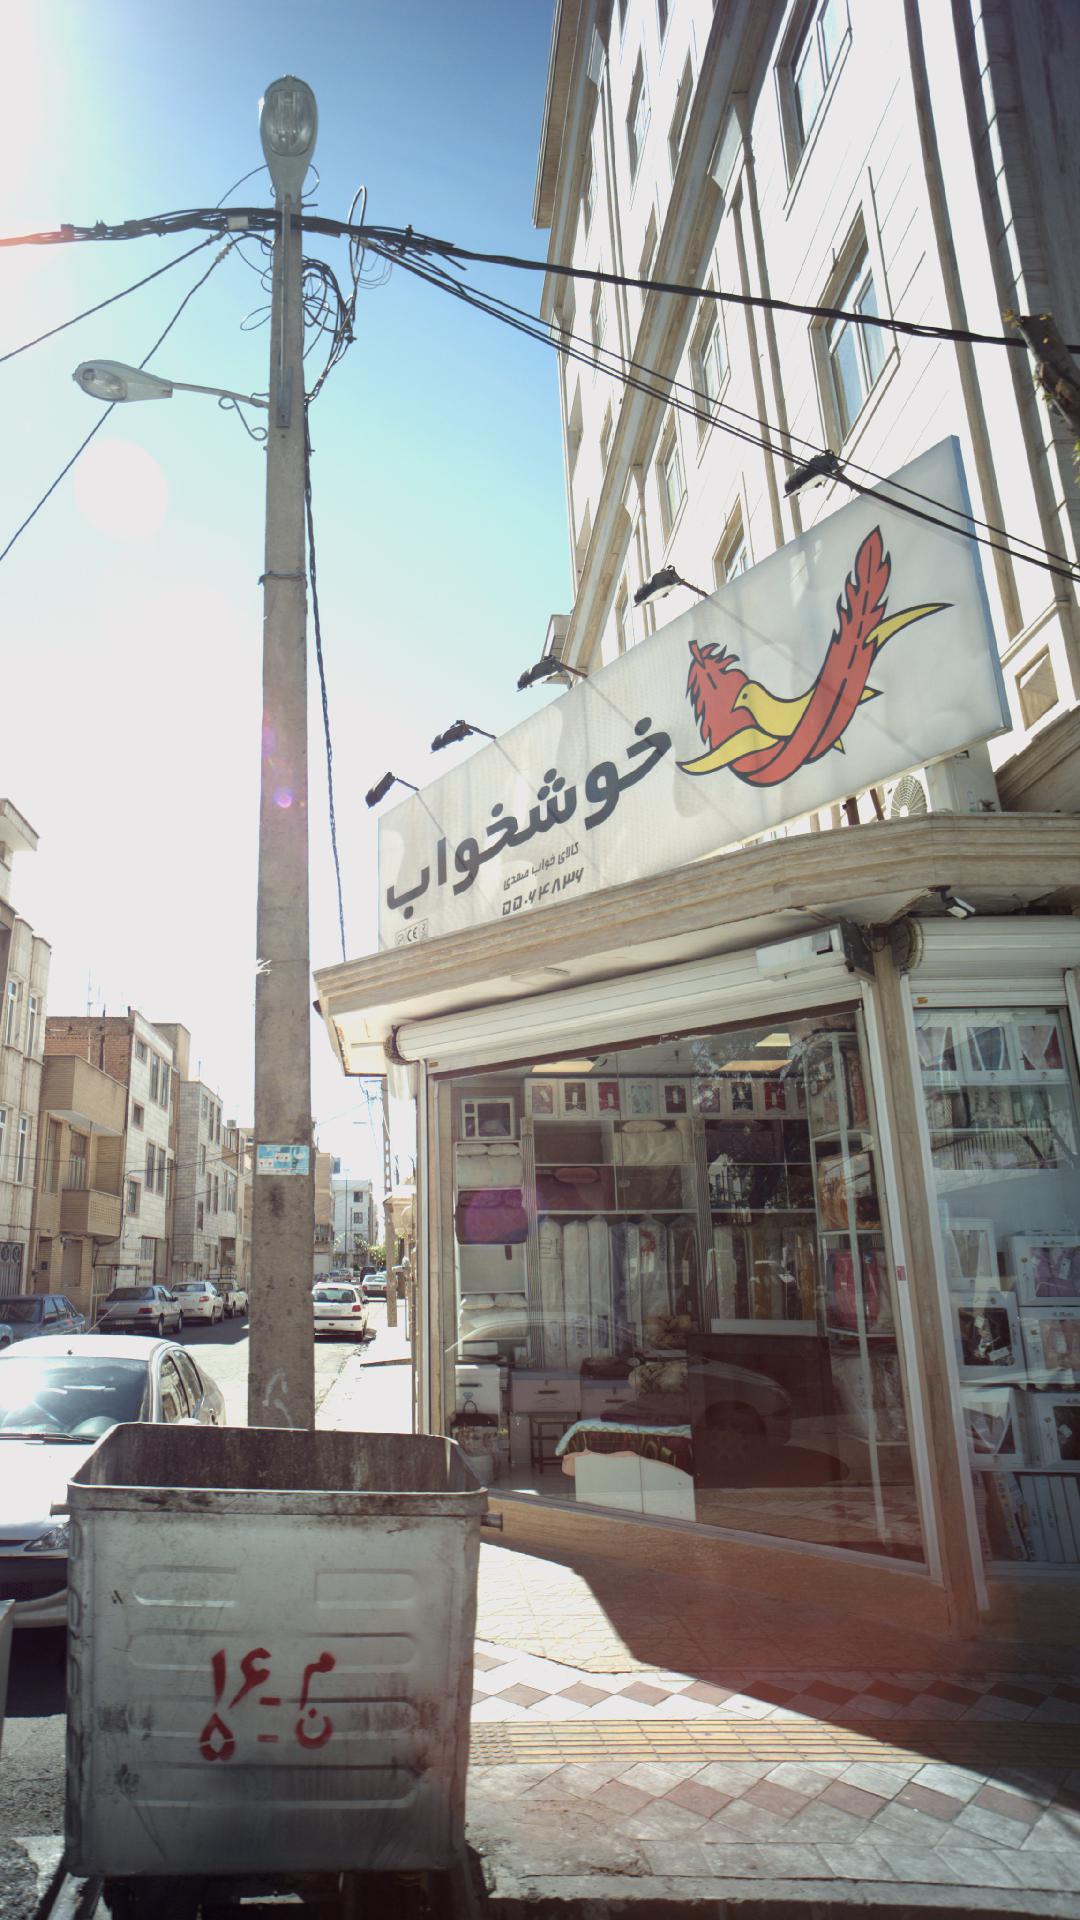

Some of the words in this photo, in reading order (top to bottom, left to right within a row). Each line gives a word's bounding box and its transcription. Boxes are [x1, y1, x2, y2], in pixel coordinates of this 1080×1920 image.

[387, 717, 672, 919] خوشخواب
[557, 842, 579, 865] کالای
[531, 854, 556, 877] خواب
